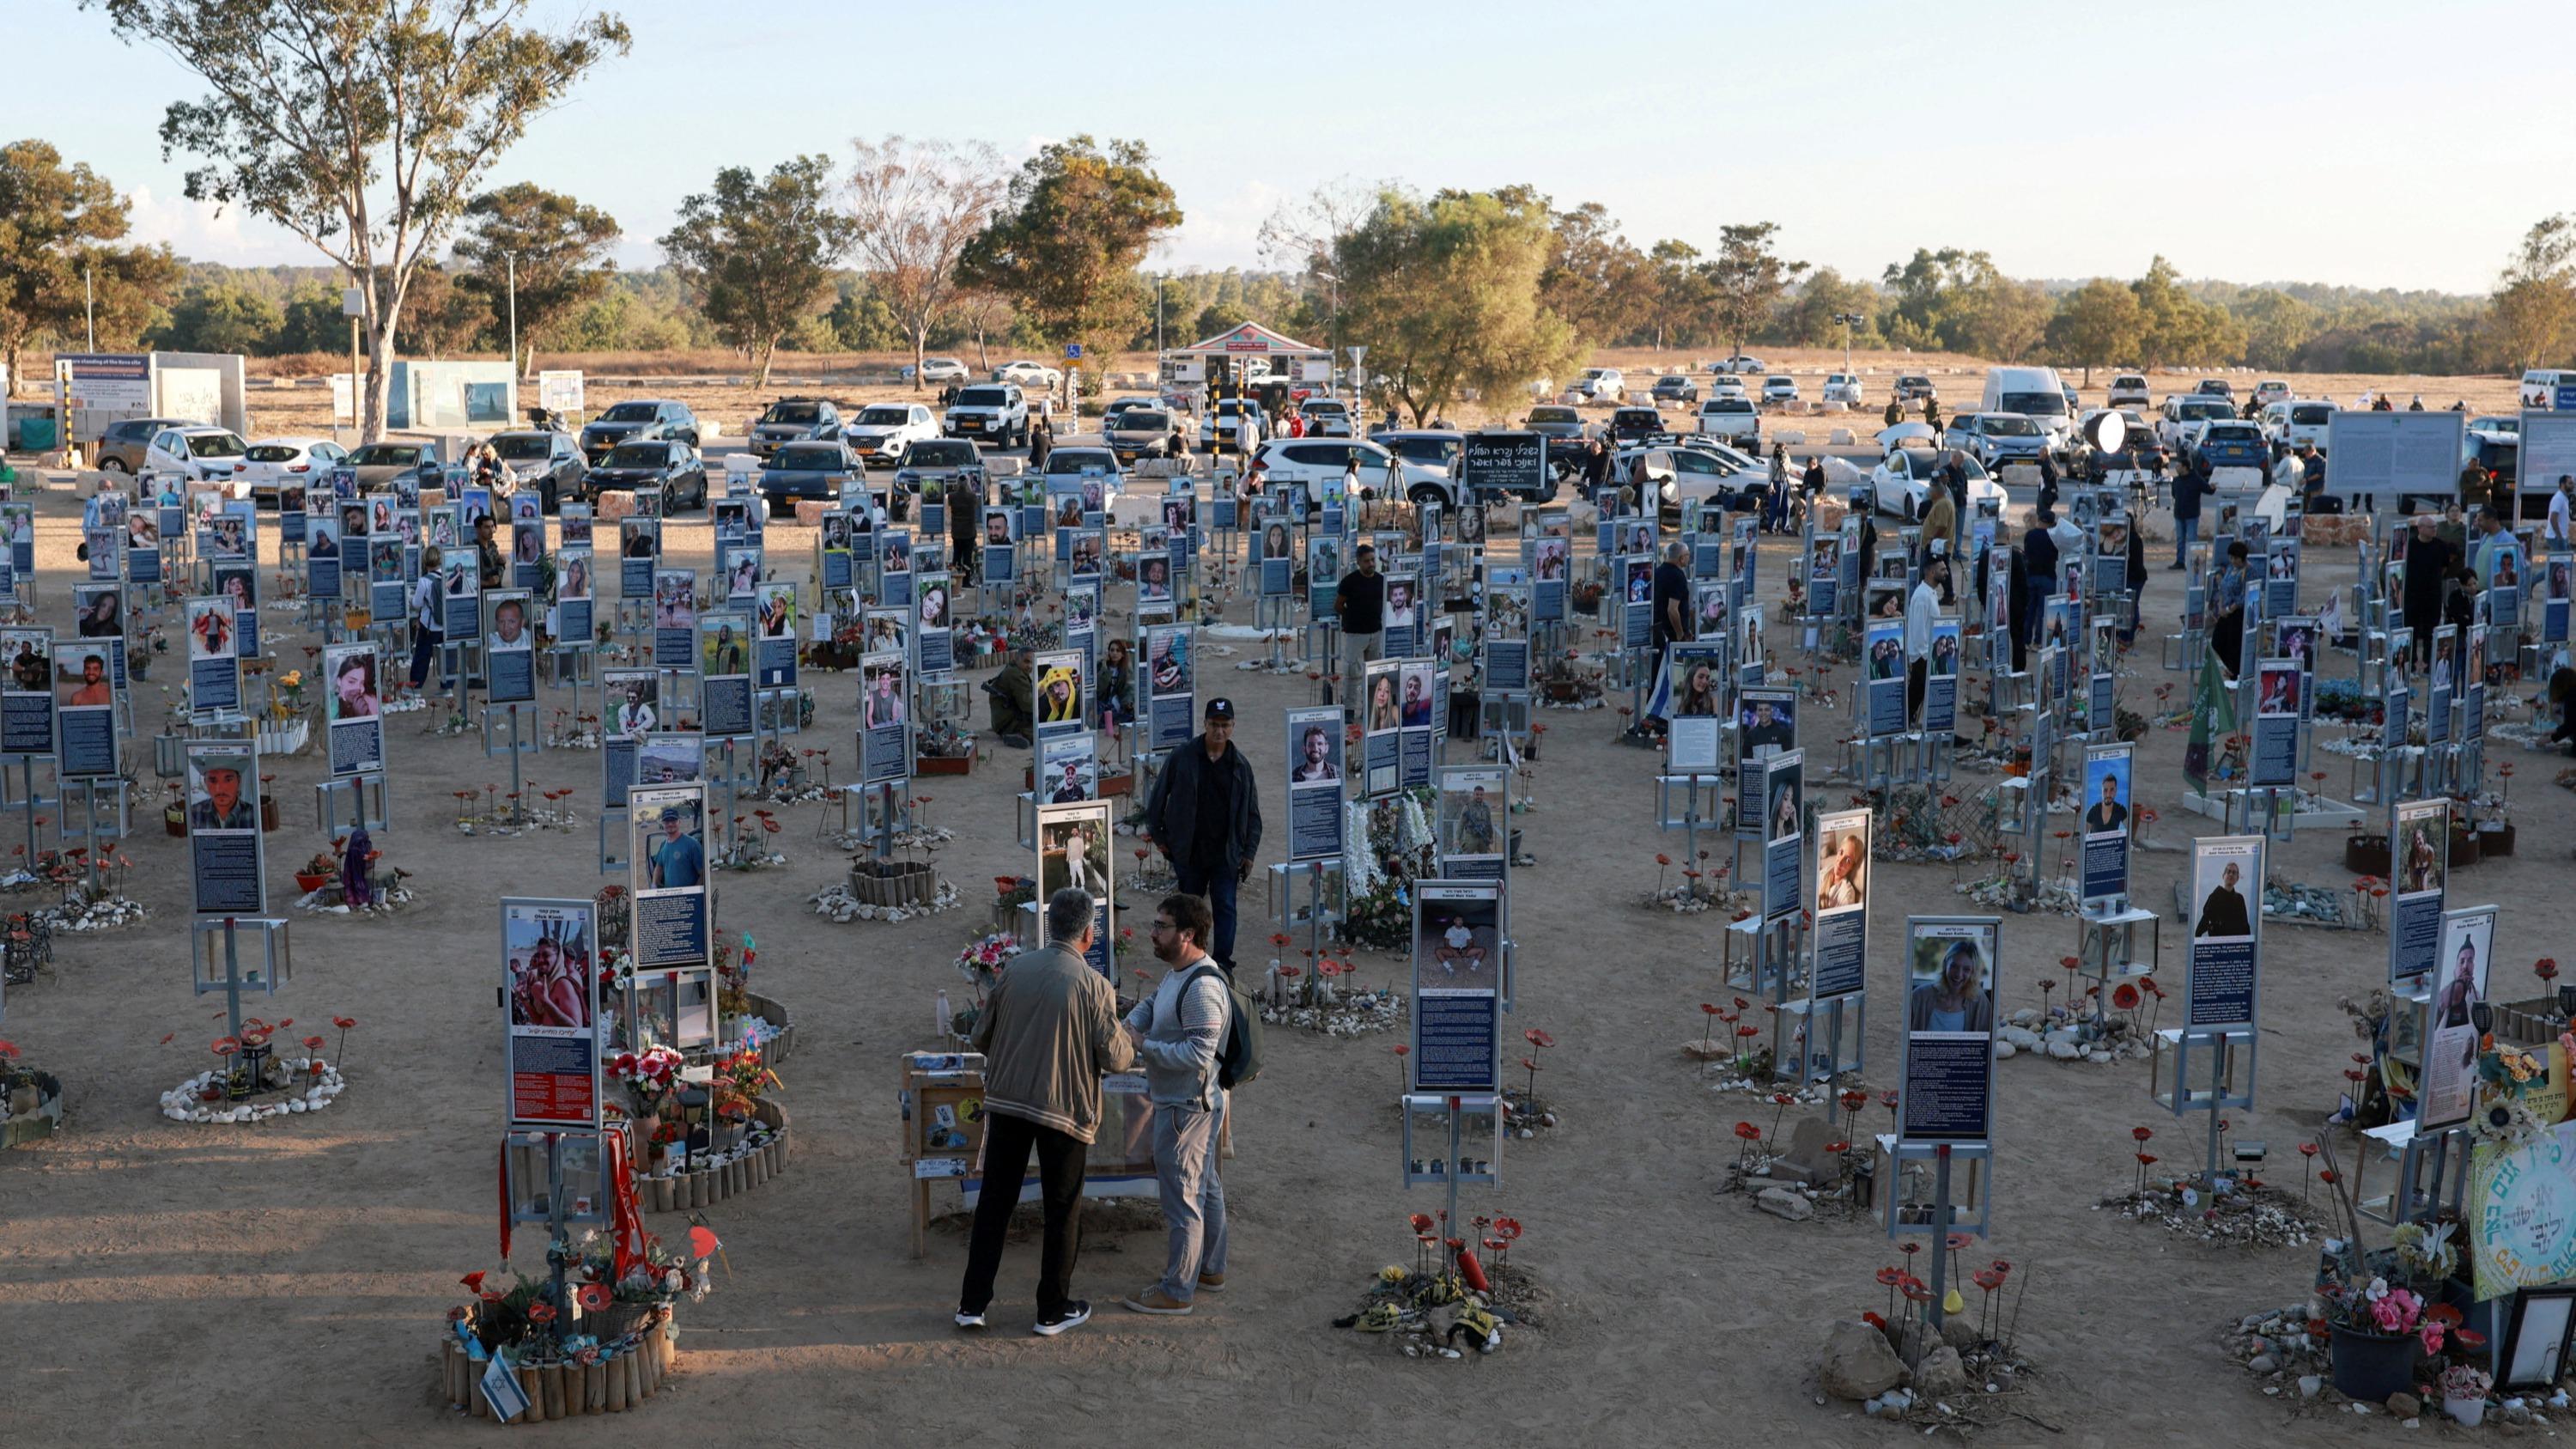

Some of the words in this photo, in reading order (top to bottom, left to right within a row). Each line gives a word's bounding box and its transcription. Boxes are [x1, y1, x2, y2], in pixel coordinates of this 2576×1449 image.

[1493, 447, 1513, 458] נברא
[1516, 442, 1539, 455] בשבילי
[1470, 458, 1492, 467] ואפר
[1494, 458, 1512, 467] עפר
